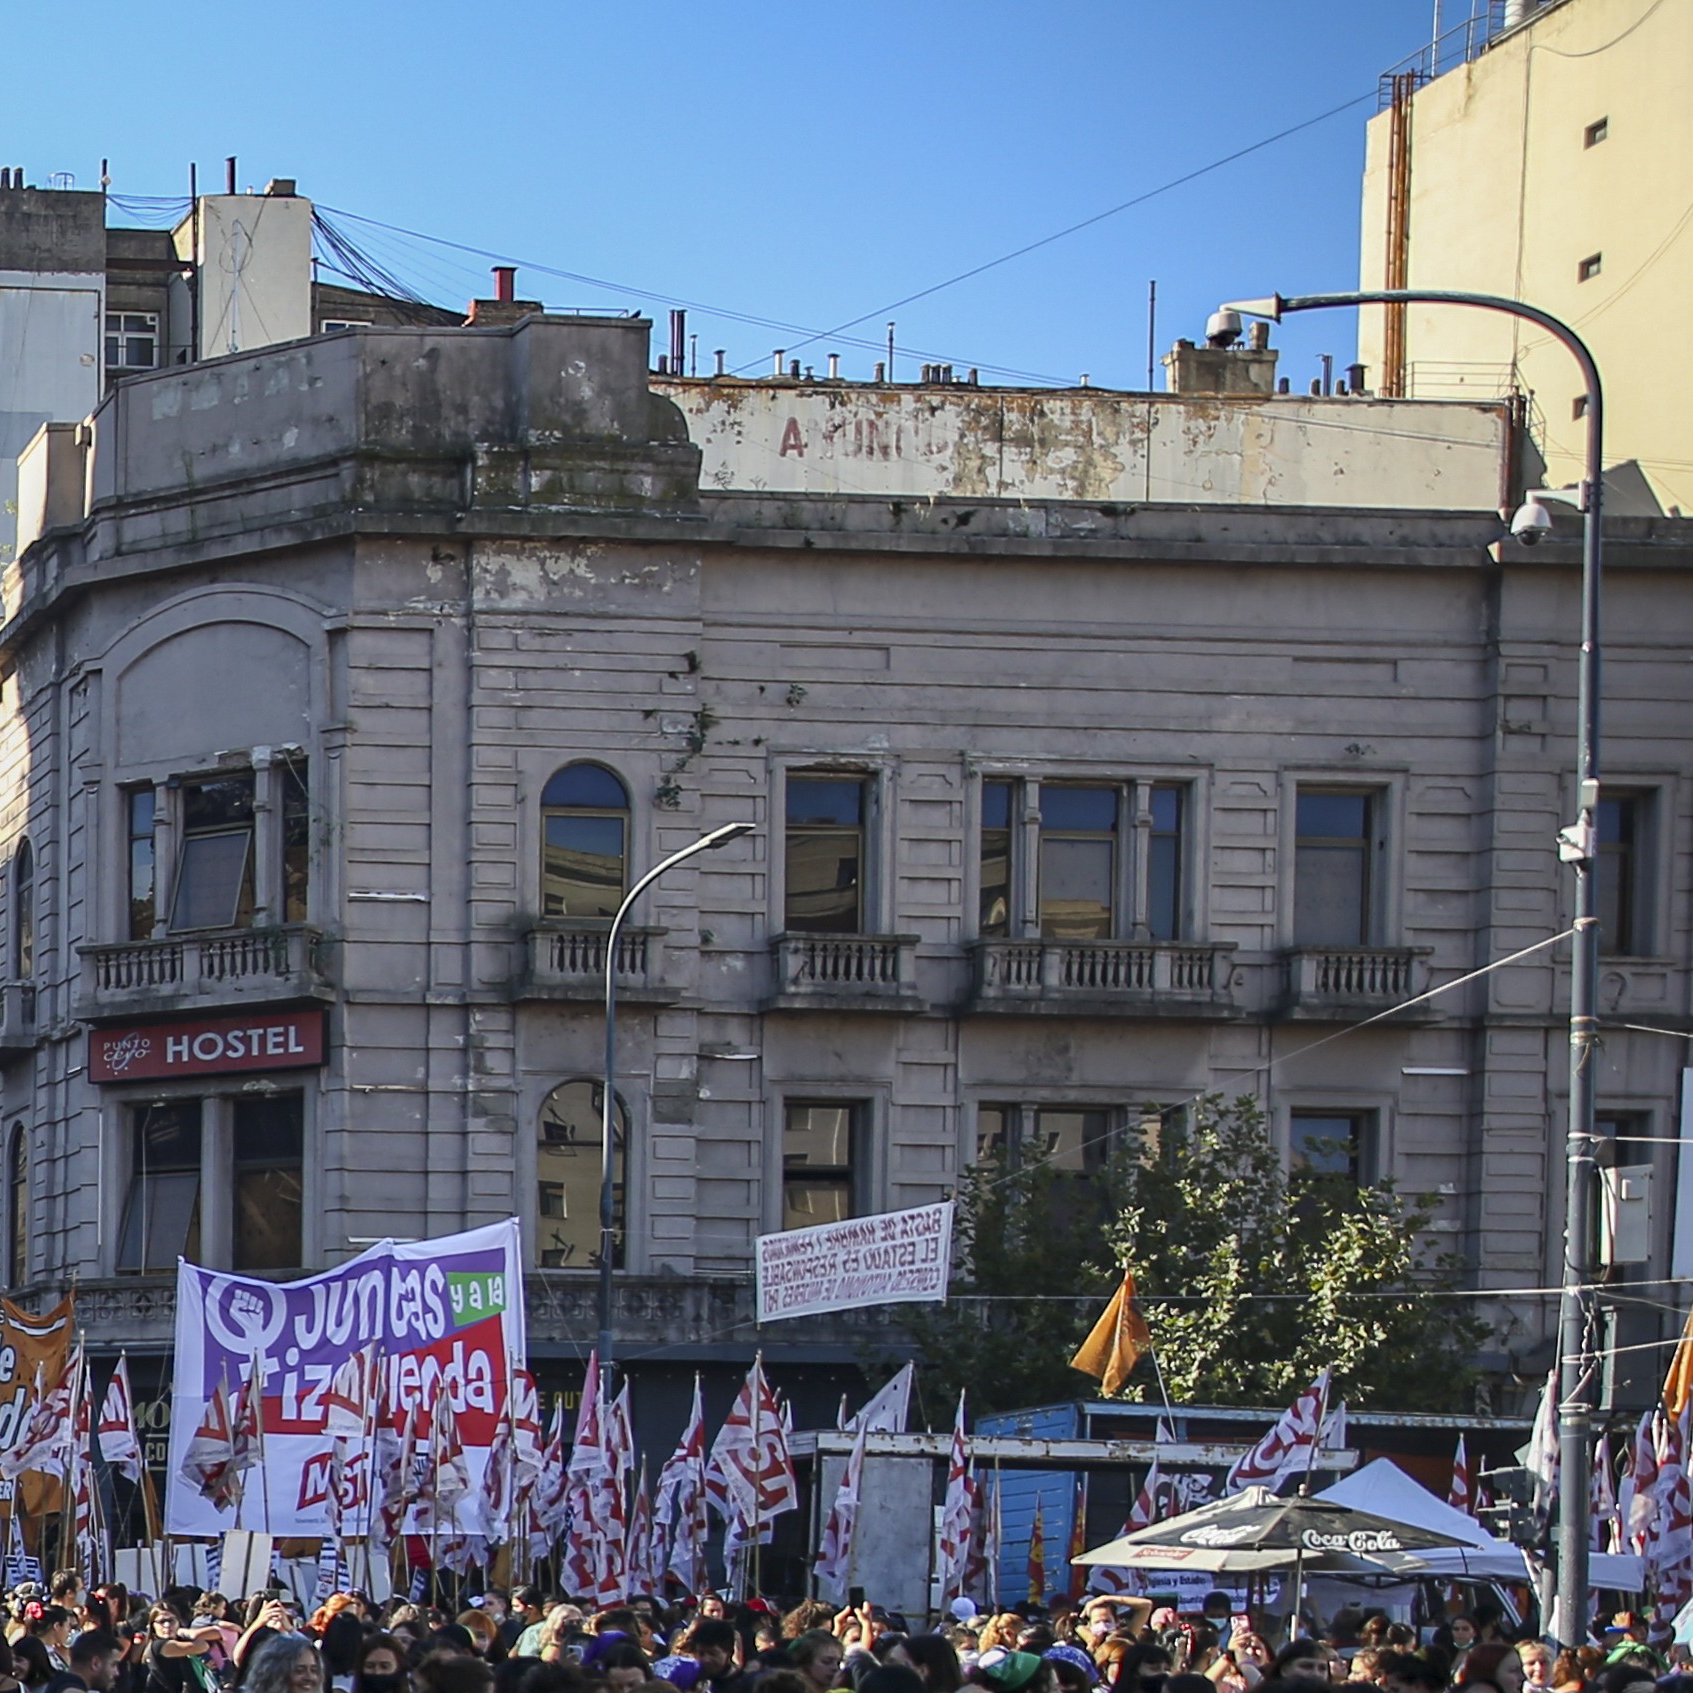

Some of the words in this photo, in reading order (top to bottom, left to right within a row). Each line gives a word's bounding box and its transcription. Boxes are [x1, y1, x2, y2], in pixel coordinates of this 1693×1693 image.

[103, 1038, 151, 1051] PUNTO
[166, 1025, 304, 1064] HOSTEL
[1302, 1527, 1401, 1553] Coca-Cola
